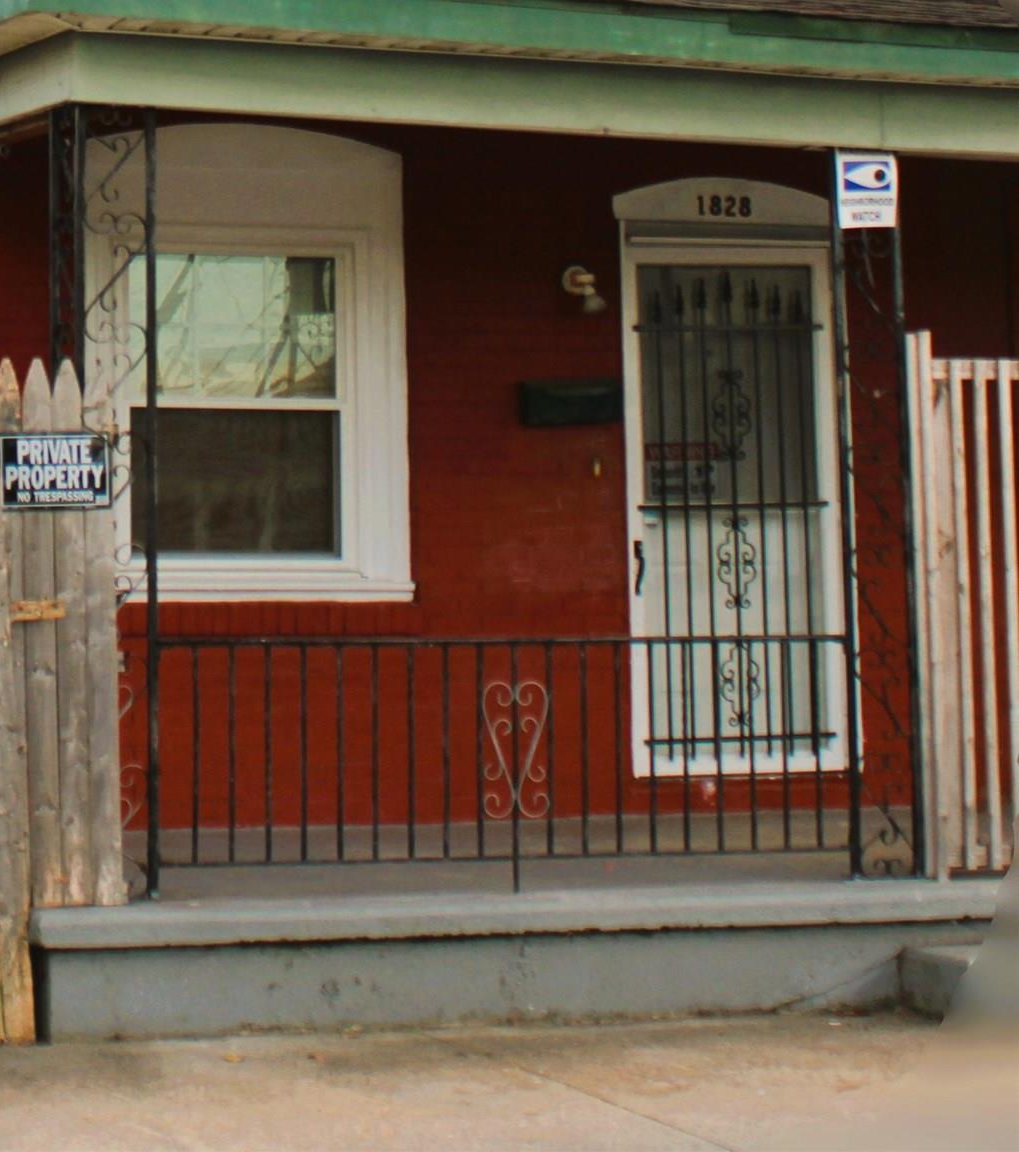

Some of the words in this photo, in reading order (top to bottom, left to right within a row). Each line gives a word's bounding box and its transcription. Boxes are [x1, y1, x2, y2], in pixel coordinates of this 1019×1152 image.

[697, 195, 752, 218] 1828
[16, 439, 92, 464] PRIVATE
[5, 465, 103, 490] PROPERTY
[17, 491, 31, 503] NO
[34, 490, 94, 503] TRESPASSING
